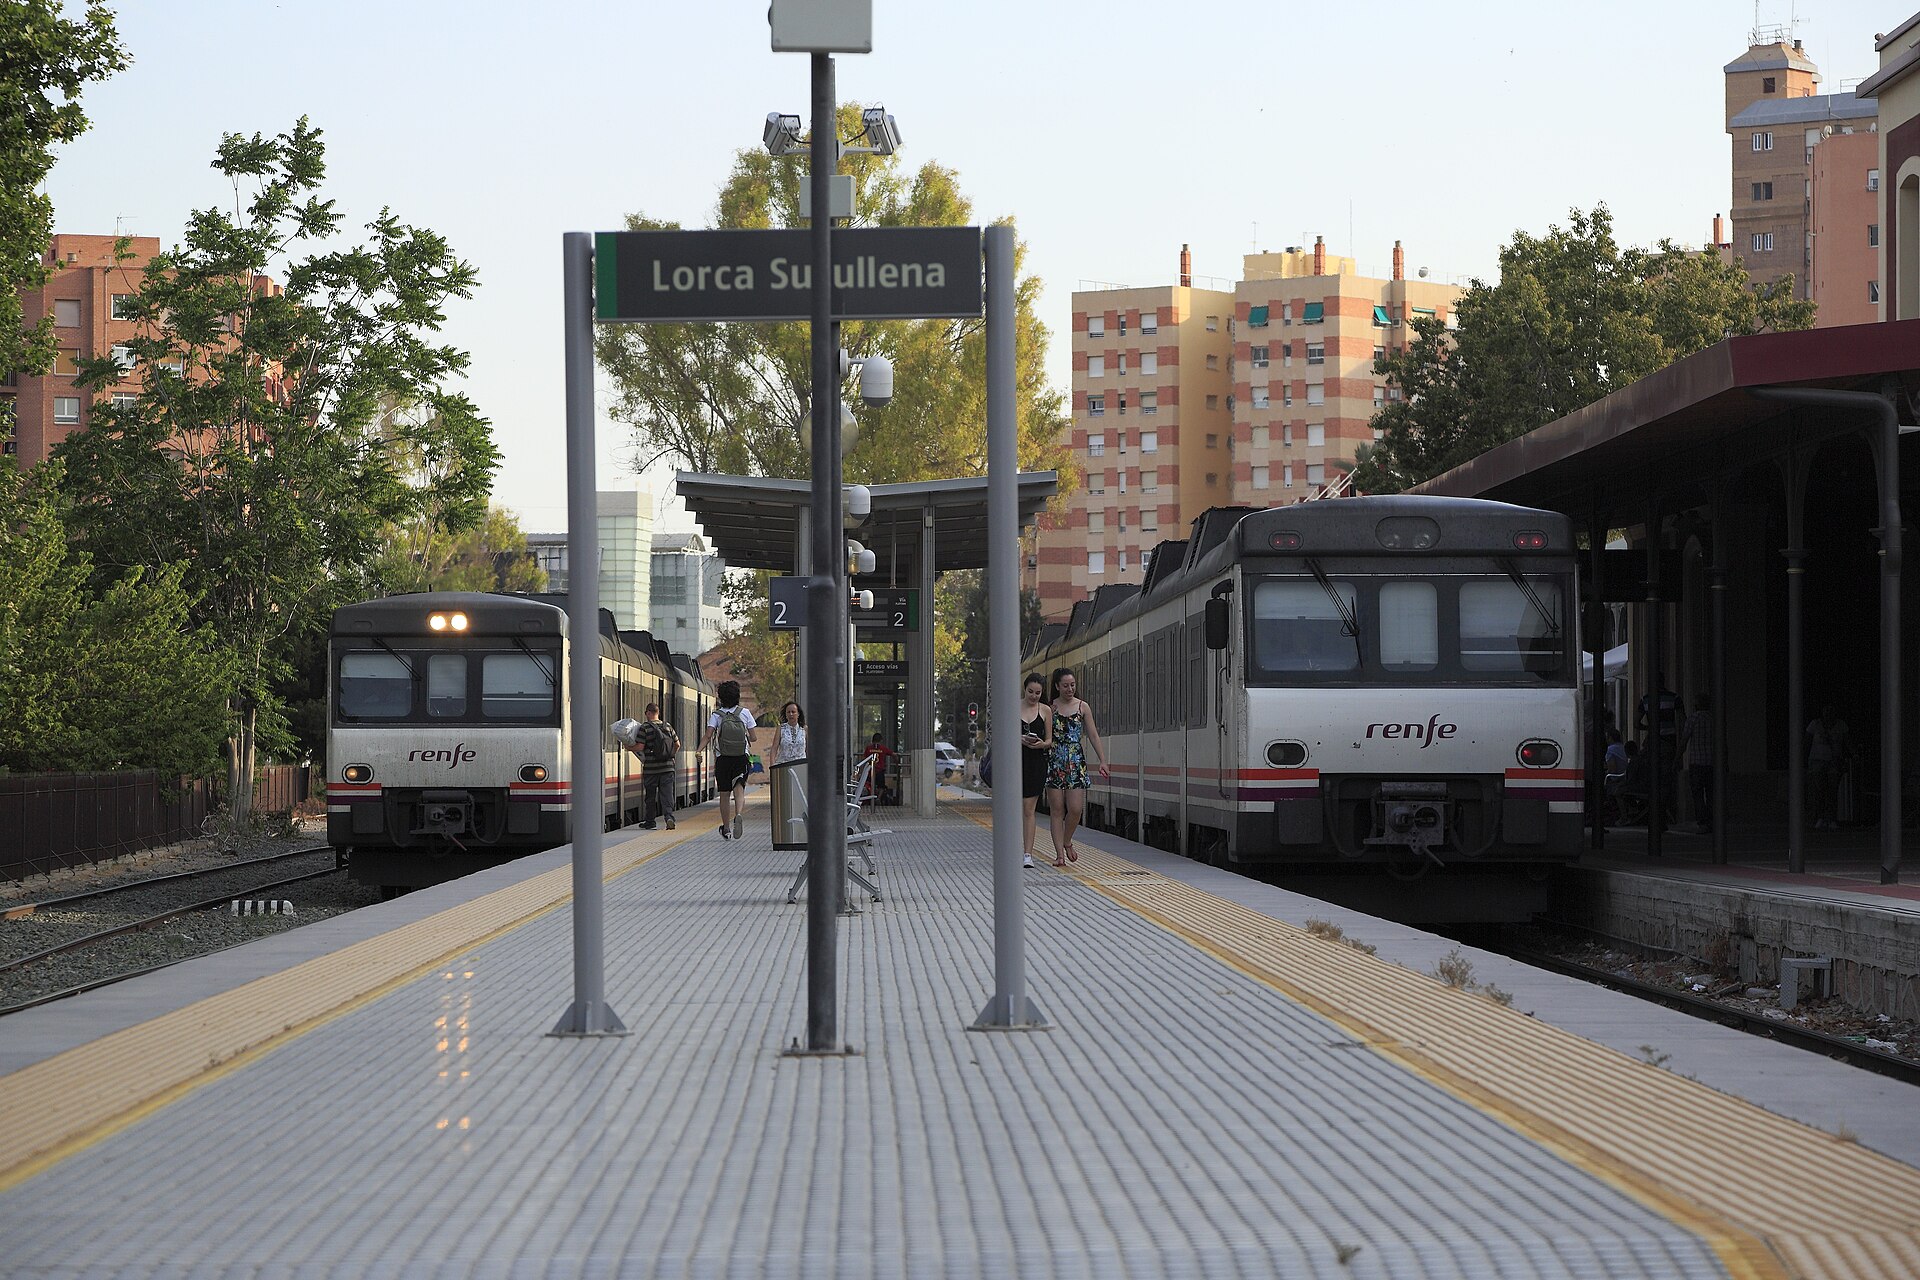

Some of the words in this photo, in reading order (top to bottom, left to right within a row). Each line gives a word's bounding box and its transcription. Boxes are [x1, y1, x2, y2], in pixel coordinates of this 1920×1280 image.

[653, 260, 754, 291] Lorca
[770, 256, 946, 290] Suullena
[774, 601, 787, 624] 2
[894, 612, 904, 627] 2
[857, 663, 864, 674] 1
[1365, 713, 1458, 749] renfe
[408, 742, 477, 770] renfe
